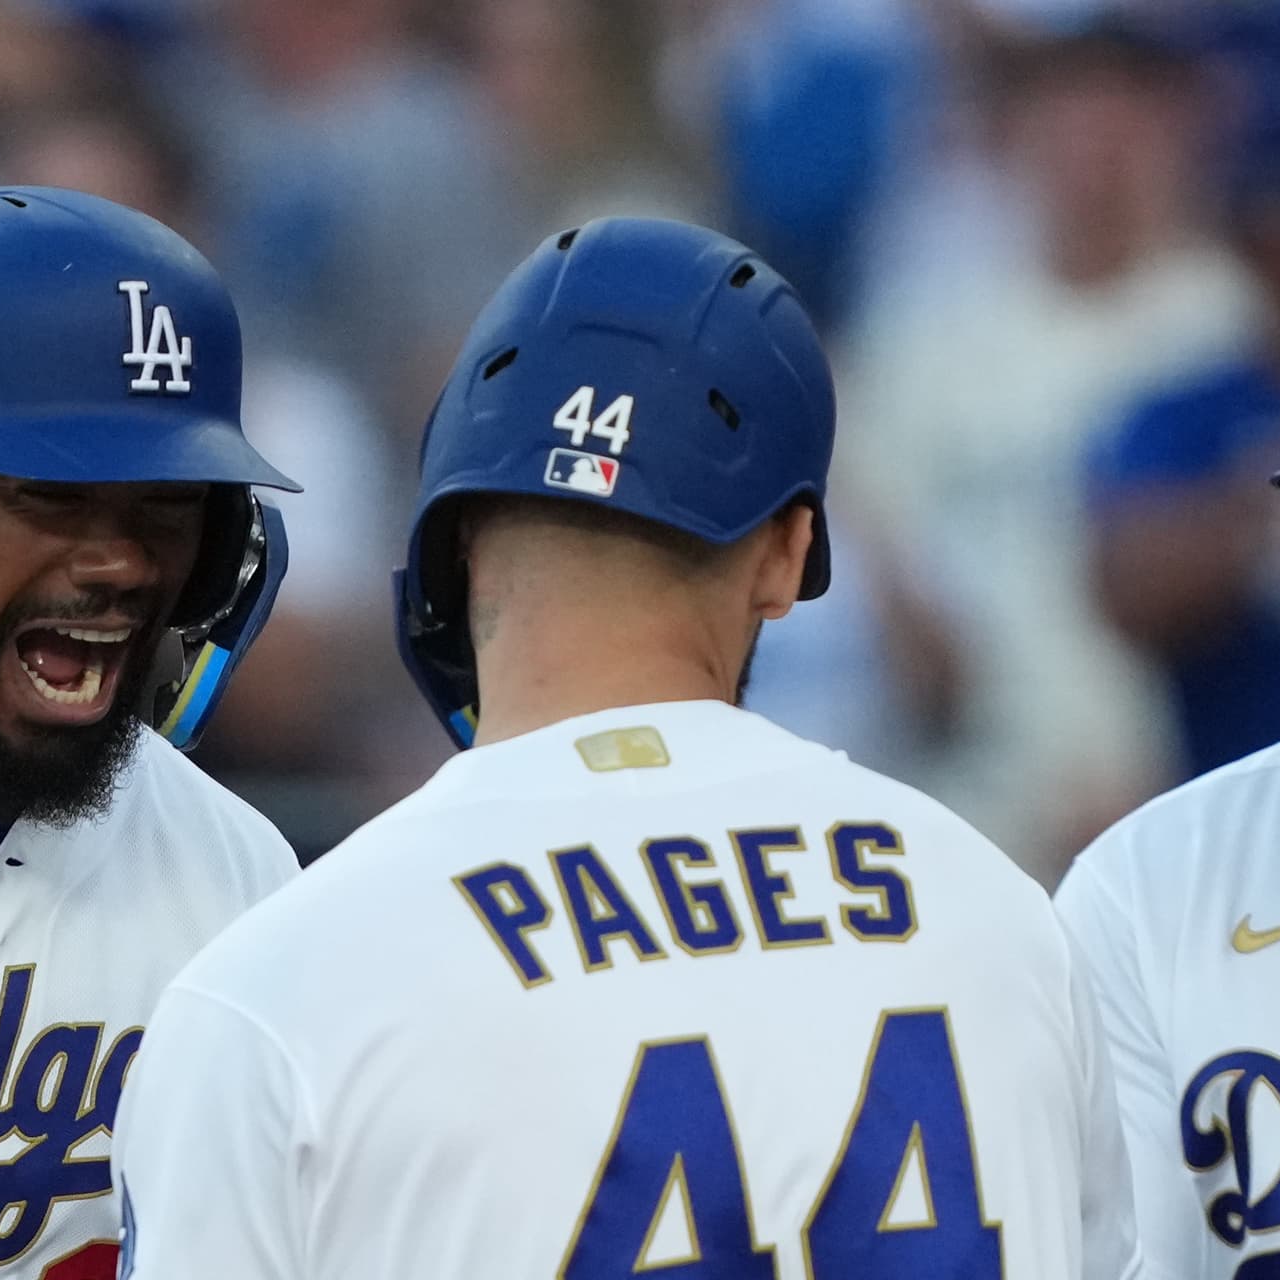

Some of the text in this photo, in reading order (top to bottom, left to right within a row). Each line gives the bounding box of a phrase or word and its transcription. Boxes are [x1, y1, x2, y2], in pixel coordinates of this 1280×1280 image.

[118, 280, 192, 392] LA
[553, 385, 634, 455] 44
[450, 820, 919, 989] PAGES
